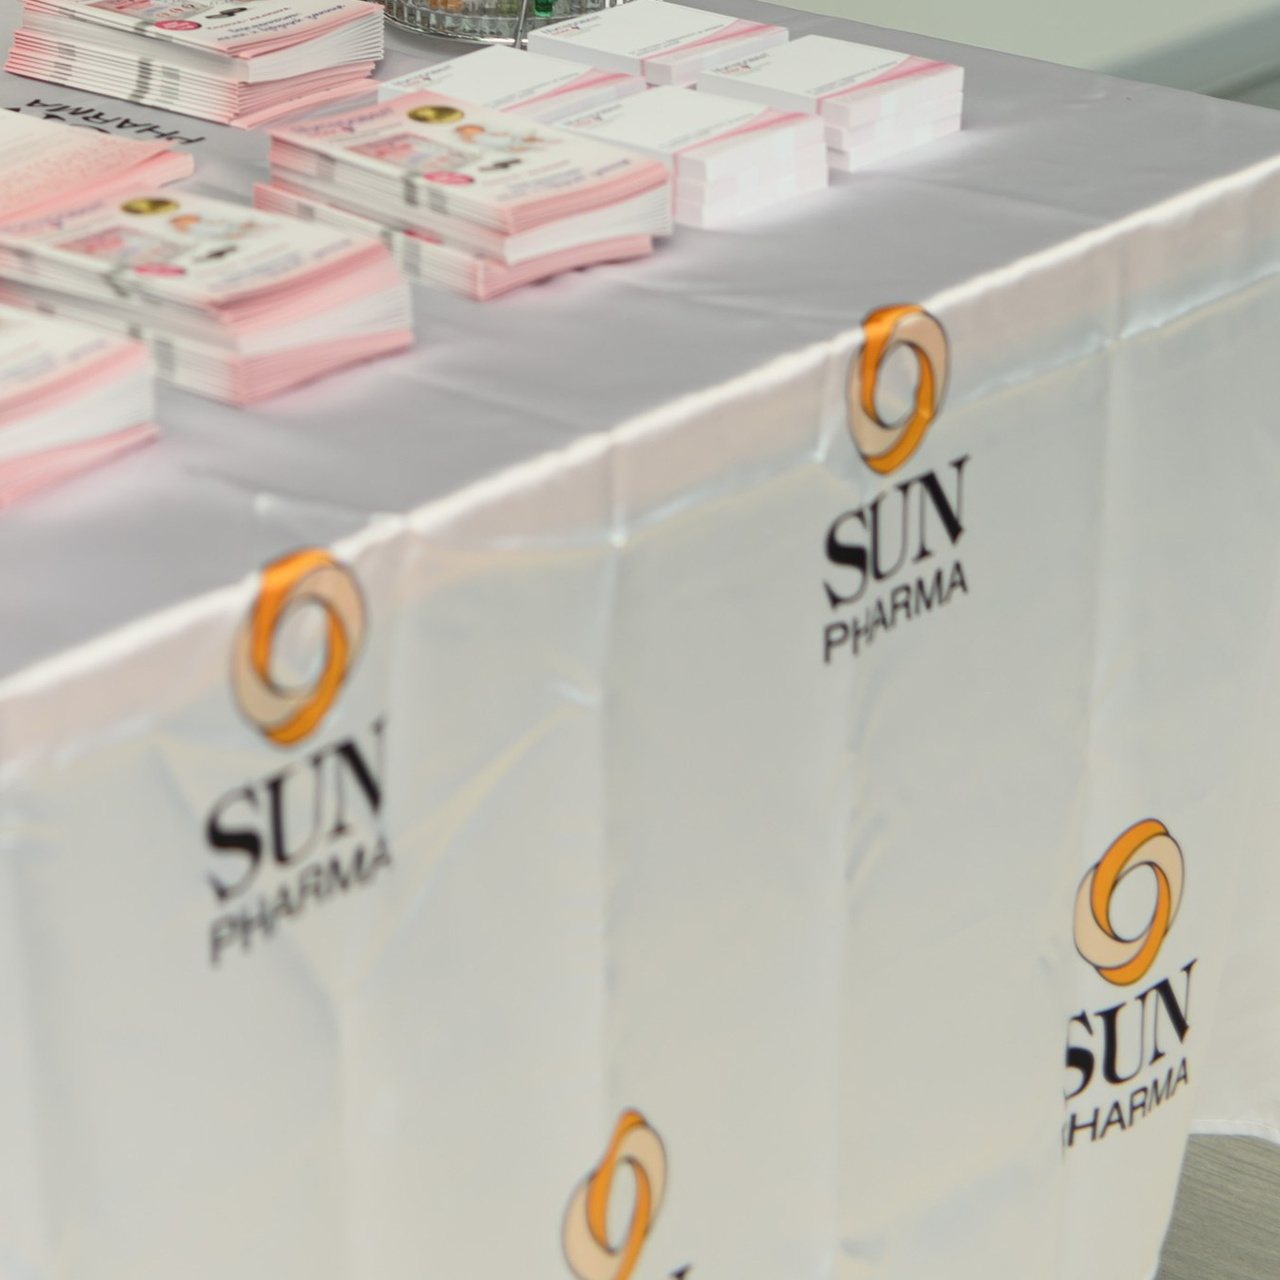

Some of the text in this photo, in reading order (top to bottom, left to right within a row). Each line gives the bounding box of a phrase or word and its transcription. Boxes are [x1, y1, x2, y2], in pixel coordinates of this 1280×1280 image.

[26, 98, 206, 145] PHARMA
[823, 455, 972, 610] SUN
[823, 561, 970, 666] PHARMA
[203, 719, 390, 904] SUN
[209, 834, 394, 968] PHARMA
[1063, 958, 1197, 1101] SUN
[1062, 1057, 1188, 1148] HARMA
